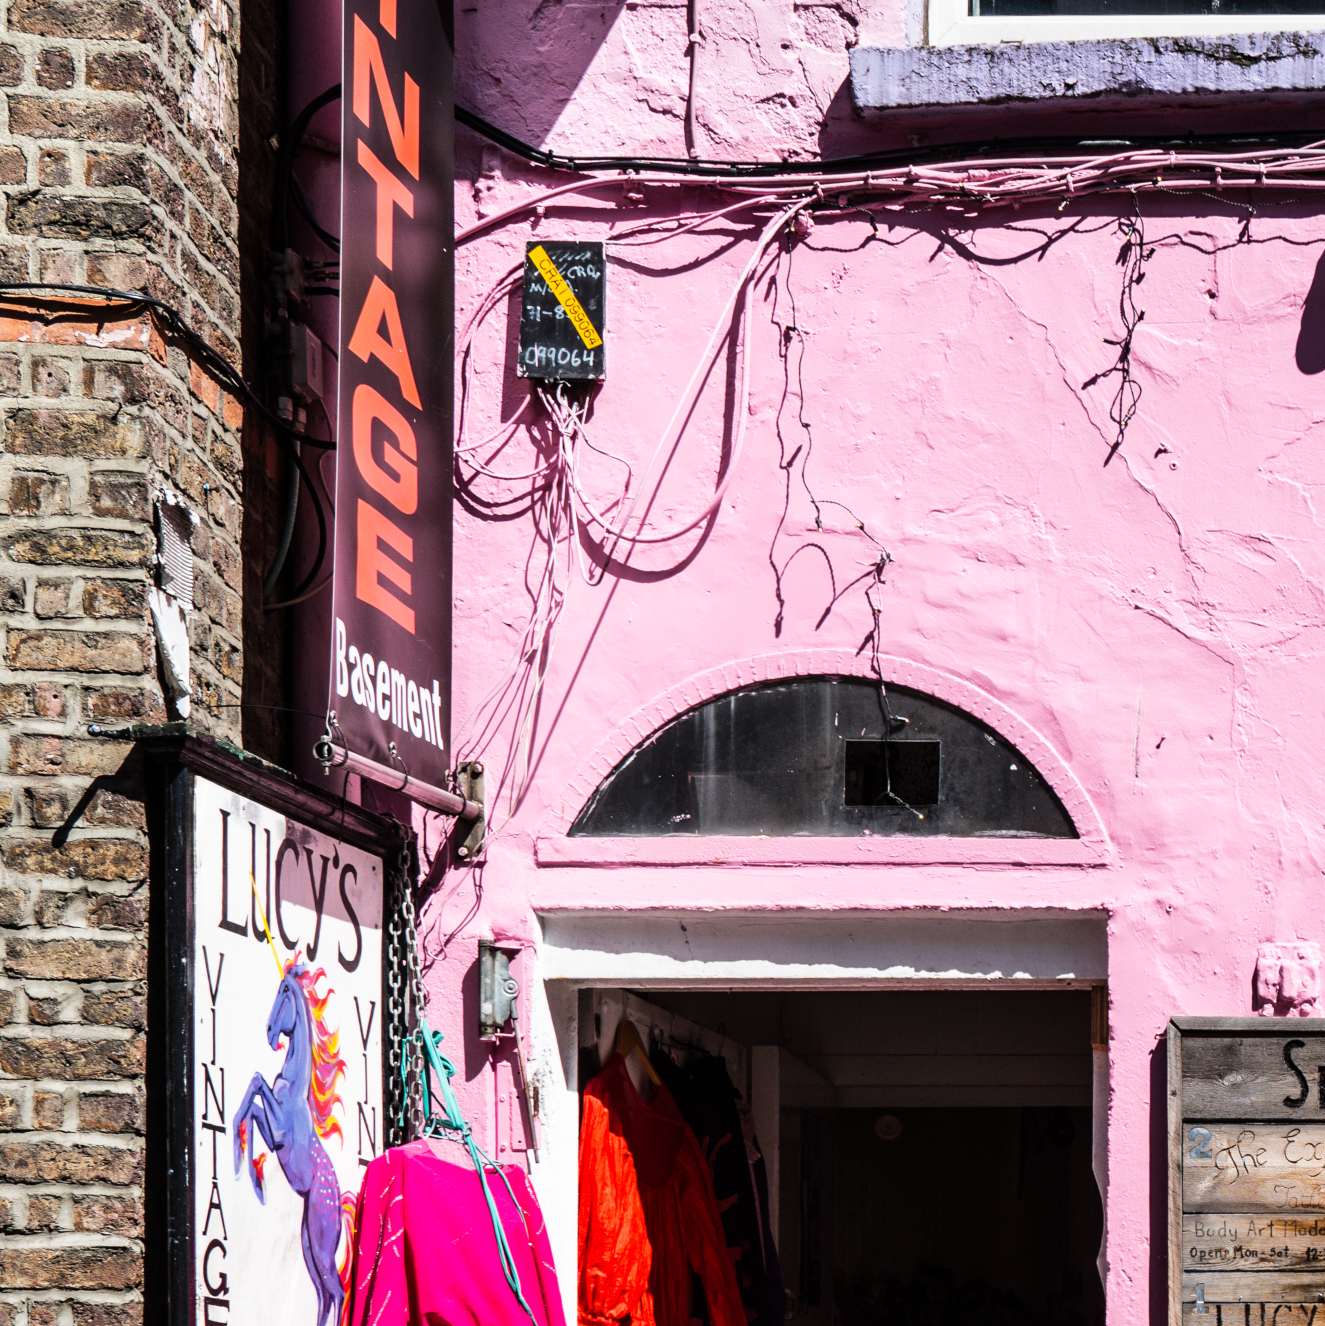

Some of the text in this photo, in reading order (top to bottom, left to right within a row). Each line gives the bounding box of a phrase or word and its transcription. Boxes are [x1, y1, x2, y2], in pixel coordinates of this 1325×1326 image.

[336, 617, 444, 750] Basement
[218, 808, 363, 973] LUCY'S
[1214, 1130, 1267, 1185] The
[1195, 1220, 1237, 1241] Body
[1247, 1220, 1275, 1237] Art
